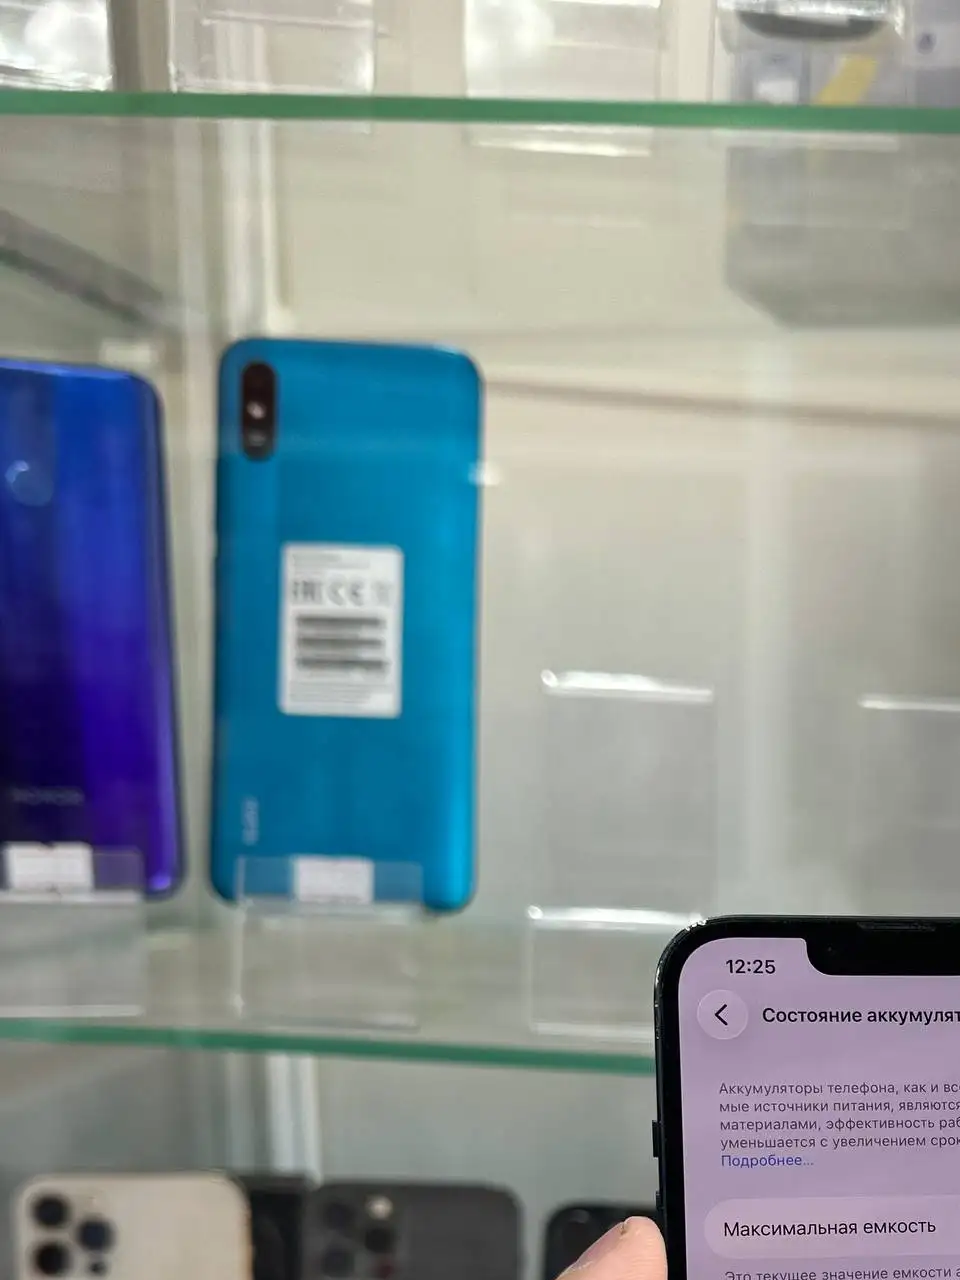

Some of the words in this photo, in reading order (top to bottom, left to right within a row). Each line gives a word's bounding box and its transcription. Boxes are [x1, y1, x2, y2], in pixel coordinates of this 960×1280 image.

[725, 959, 776, 975] 12:25
[762, 1007, 862, 1023] Состояние
[719, 1082, 823, 1097] Аккумуляторы
[827, 1081, 899, 1096] телефона,
[903, 1083, 927, 1093] как
[930, 1083, 939, 1093] и
[719, 1103, 750, 1113] мые
[754, 1102, 829, 1113] источники
[833, 1101, 894, 1113] питания,
[720, 1120, 821, 1133] материалами,
[825, 1117, 935, 1132] эффективность
[720, 1138, 816, 1152] уменьшается
[820, 1137, 828, 1148] с
[832, 1136, 926, 1150] увеличением
[724, 1221, 858, 1237] Максимальная
[863, 1221, 936, 1234] емкость
[822, 1269, 888, 1280] значение
[892, 1268, 952, 1279] емкости
